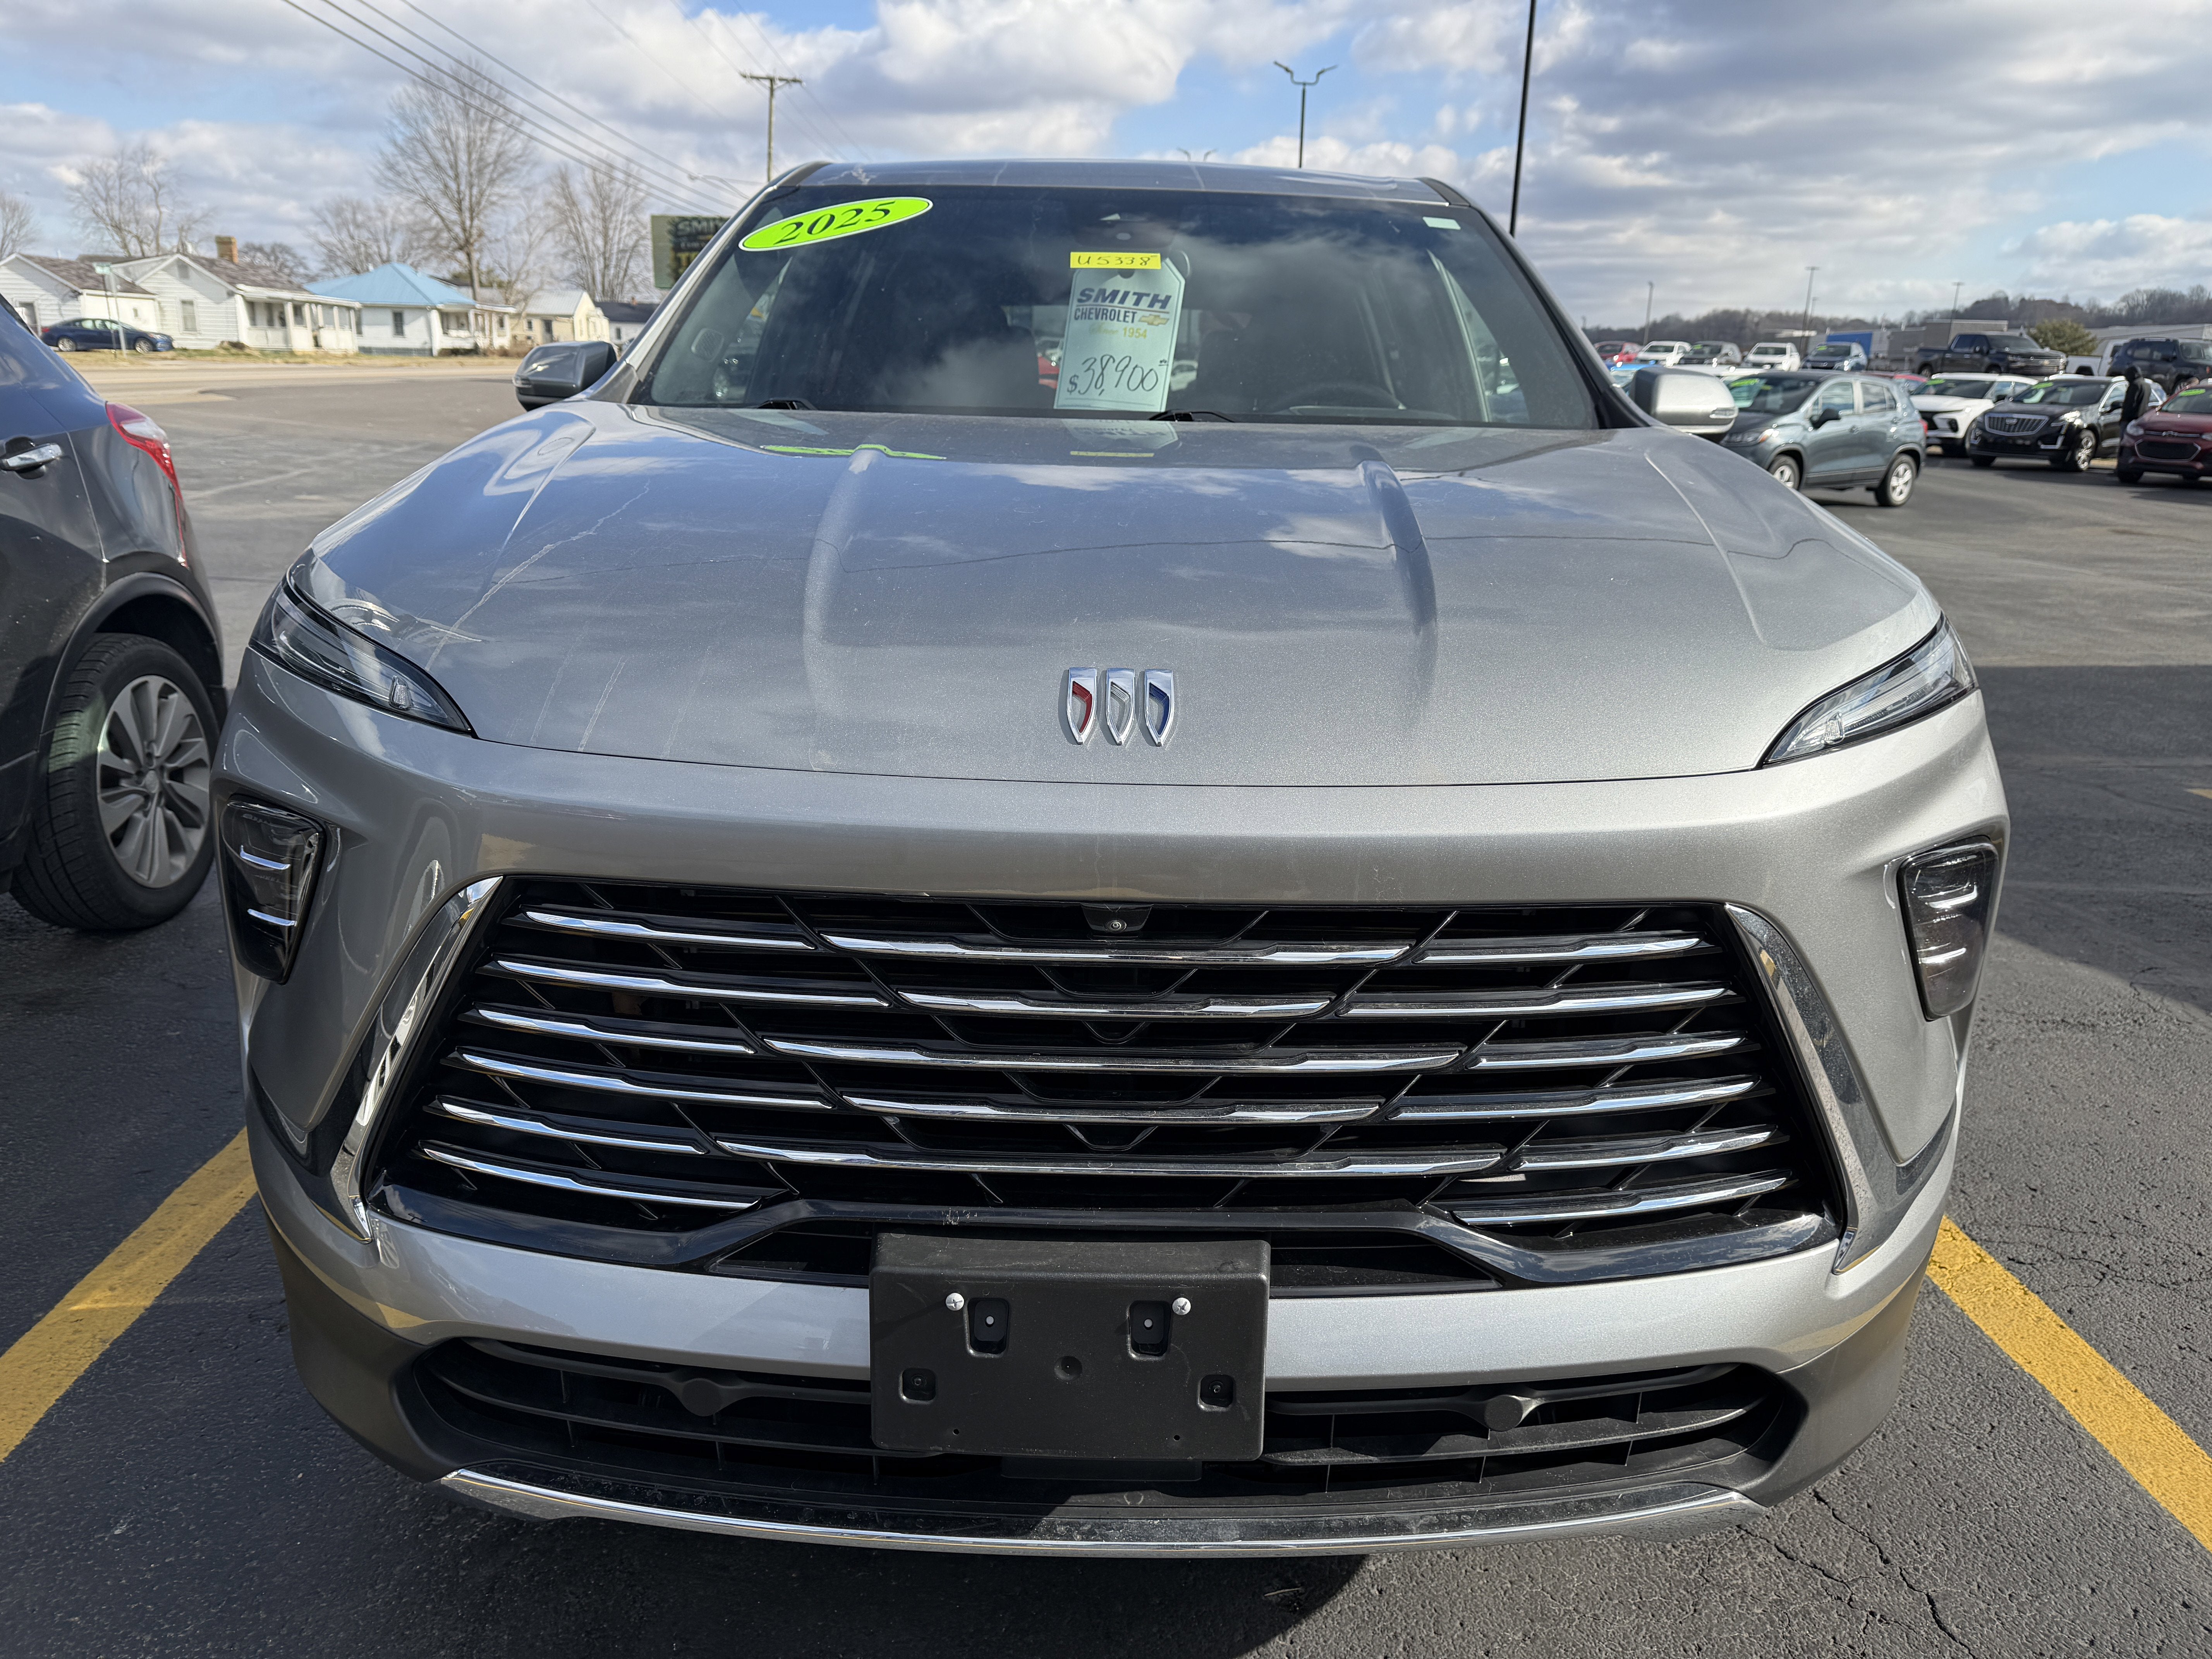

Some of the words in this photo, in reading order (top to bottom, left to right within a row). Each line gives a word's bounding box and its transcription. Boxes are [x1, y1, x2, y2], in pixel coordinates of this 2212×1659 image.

[773, 201, 896, 245] 2025
[1077, 287, 1171, 309] SMITH
[1074, 307, 1137, 323] CHEVROLET
[1123, 327, 1147, 339] 1954
